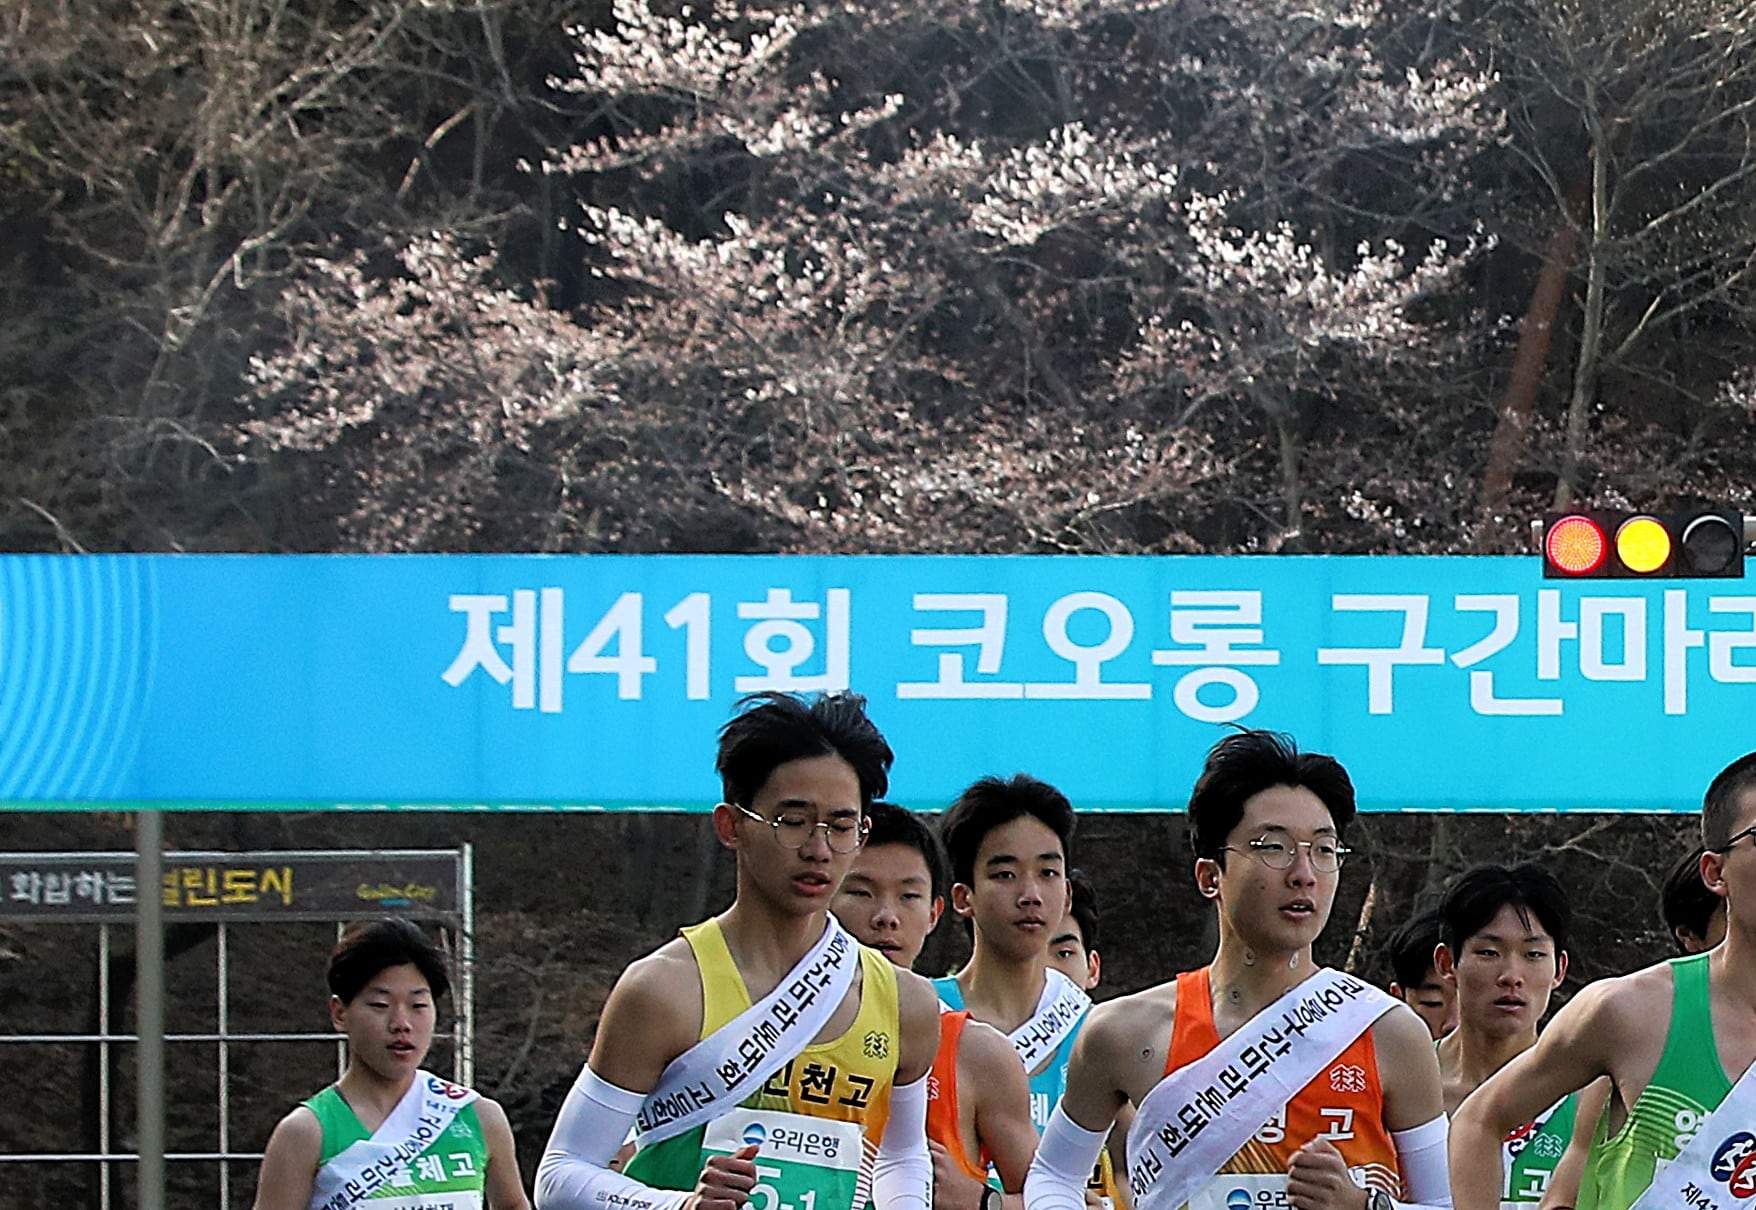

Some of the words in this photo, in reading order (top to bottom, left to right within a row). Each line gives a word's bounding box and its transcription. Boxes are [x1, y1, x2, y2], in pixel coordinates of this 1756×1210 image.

[442, 587, 850, 713] 제41회
[897, 589, 1280, 723] 코오롱
[769, 1128, 840, 1158] 우리은행
